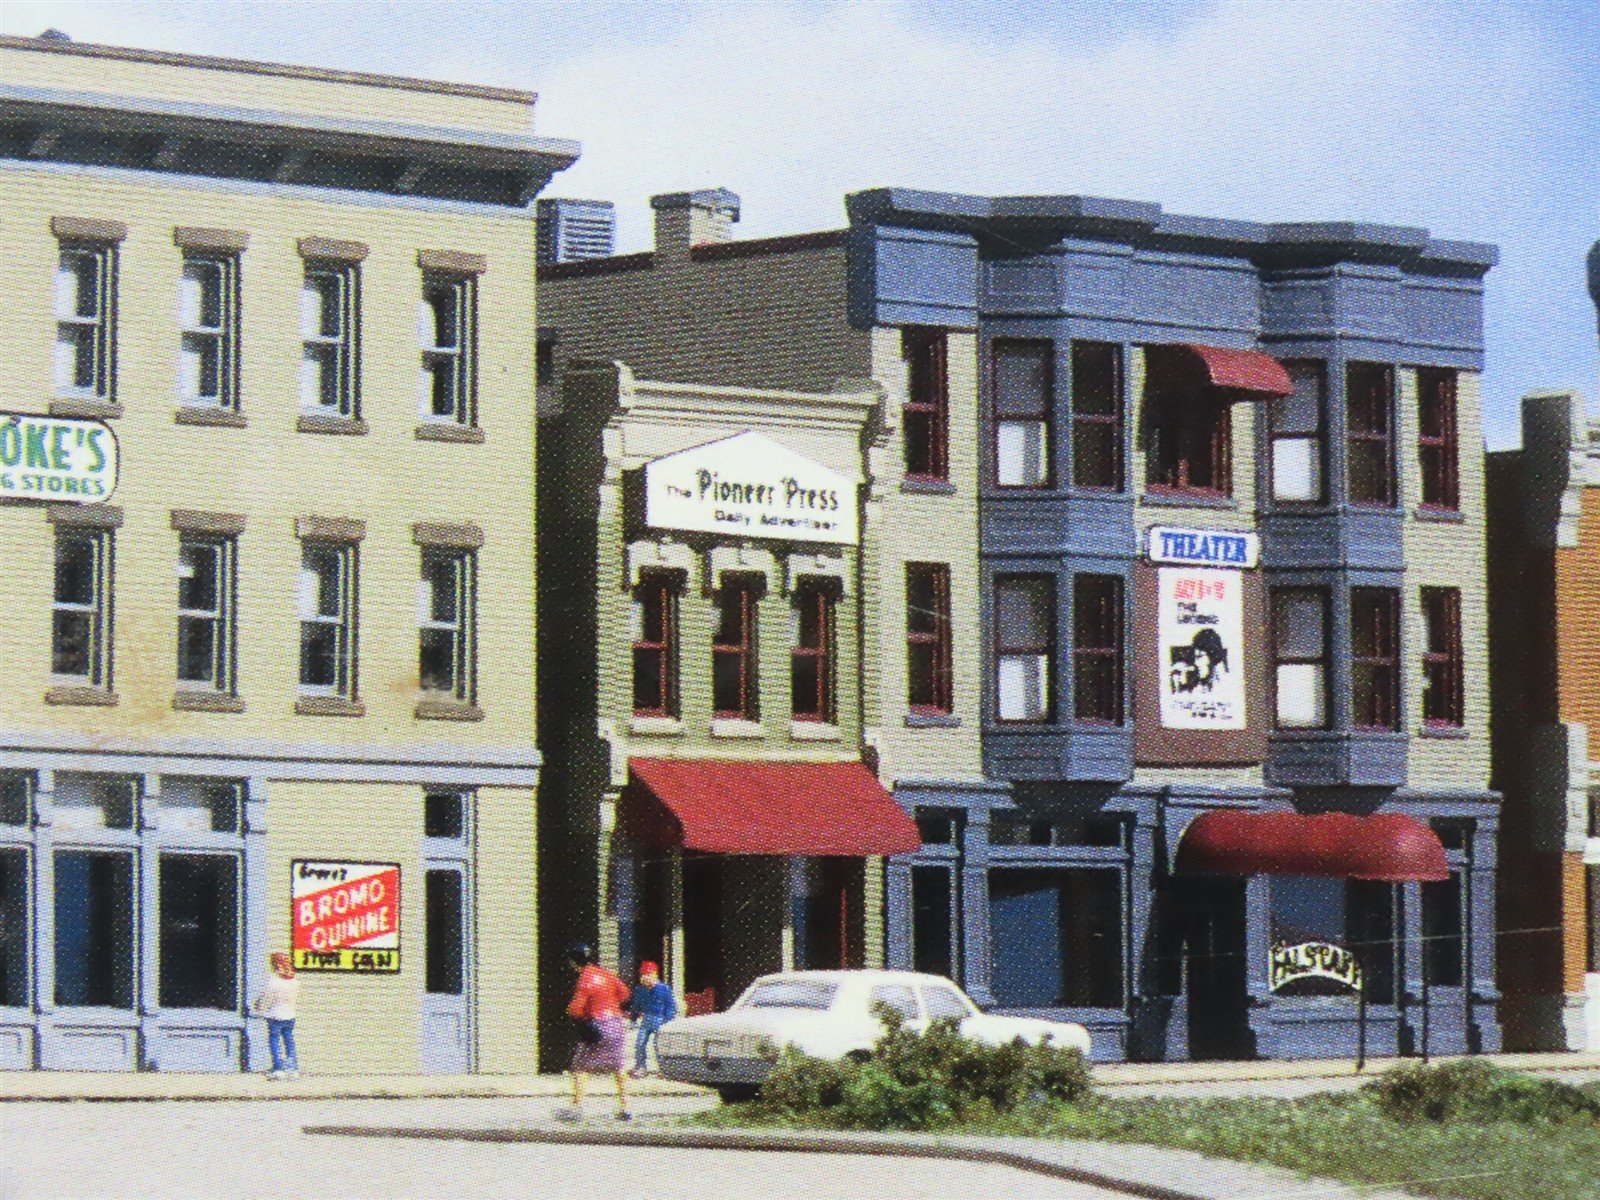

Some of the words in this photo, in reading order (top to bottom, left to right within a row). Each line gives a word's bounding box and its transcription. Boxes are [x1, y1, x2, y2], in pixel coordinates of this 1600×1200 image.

[21, 474, 105, 496] STORES
[696, 468, 775, 505] Pioneer
[780, 477, 839, 511] Press
[715, 510, 750, 526] Daily
[760, 513, 839, 530] Advertiser
[1160, 532, 1248, 563] THEATER
[300, 879, 385, 927] BROMO
